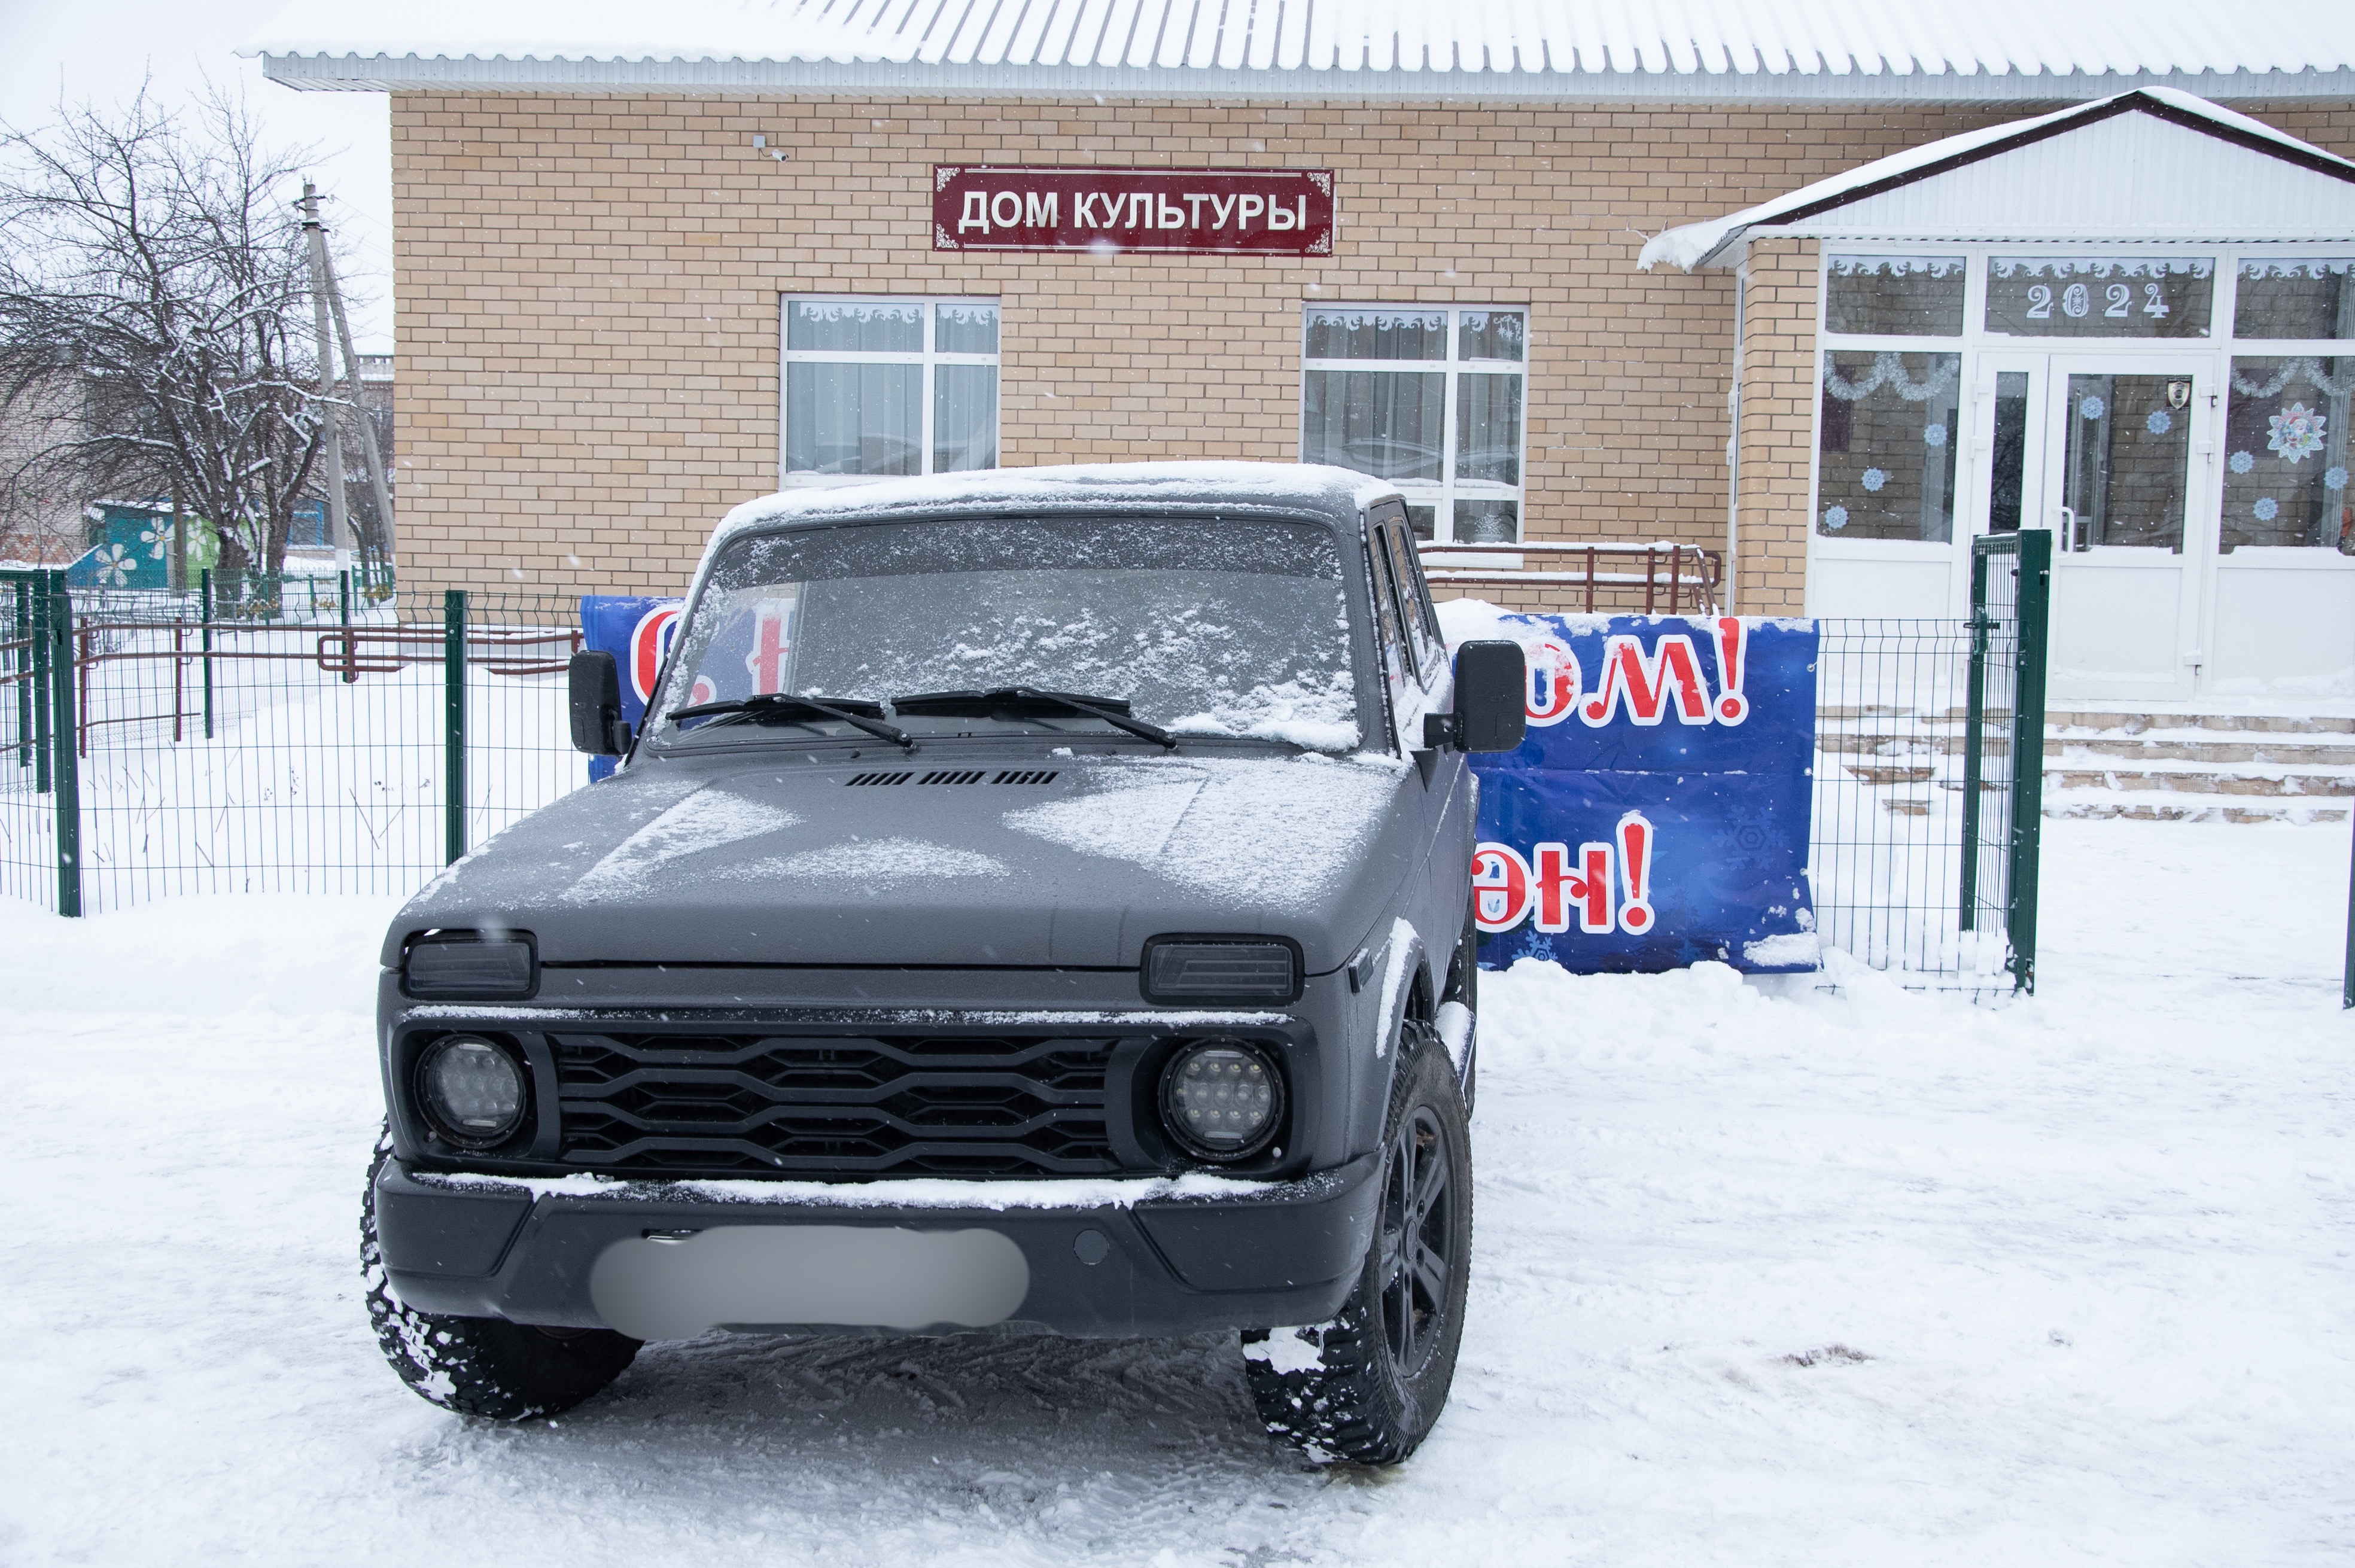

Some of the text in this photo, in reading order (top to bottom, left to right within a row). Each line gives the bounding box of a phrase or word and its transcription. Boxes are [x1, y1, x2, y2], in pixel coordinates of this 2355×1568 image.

[959, 191, 1306, 234] ДОМ КУЛЬТУРЫ
[2026, 283, 2170, 319] 2024
[1525, 616, 1749, 727] ом!
